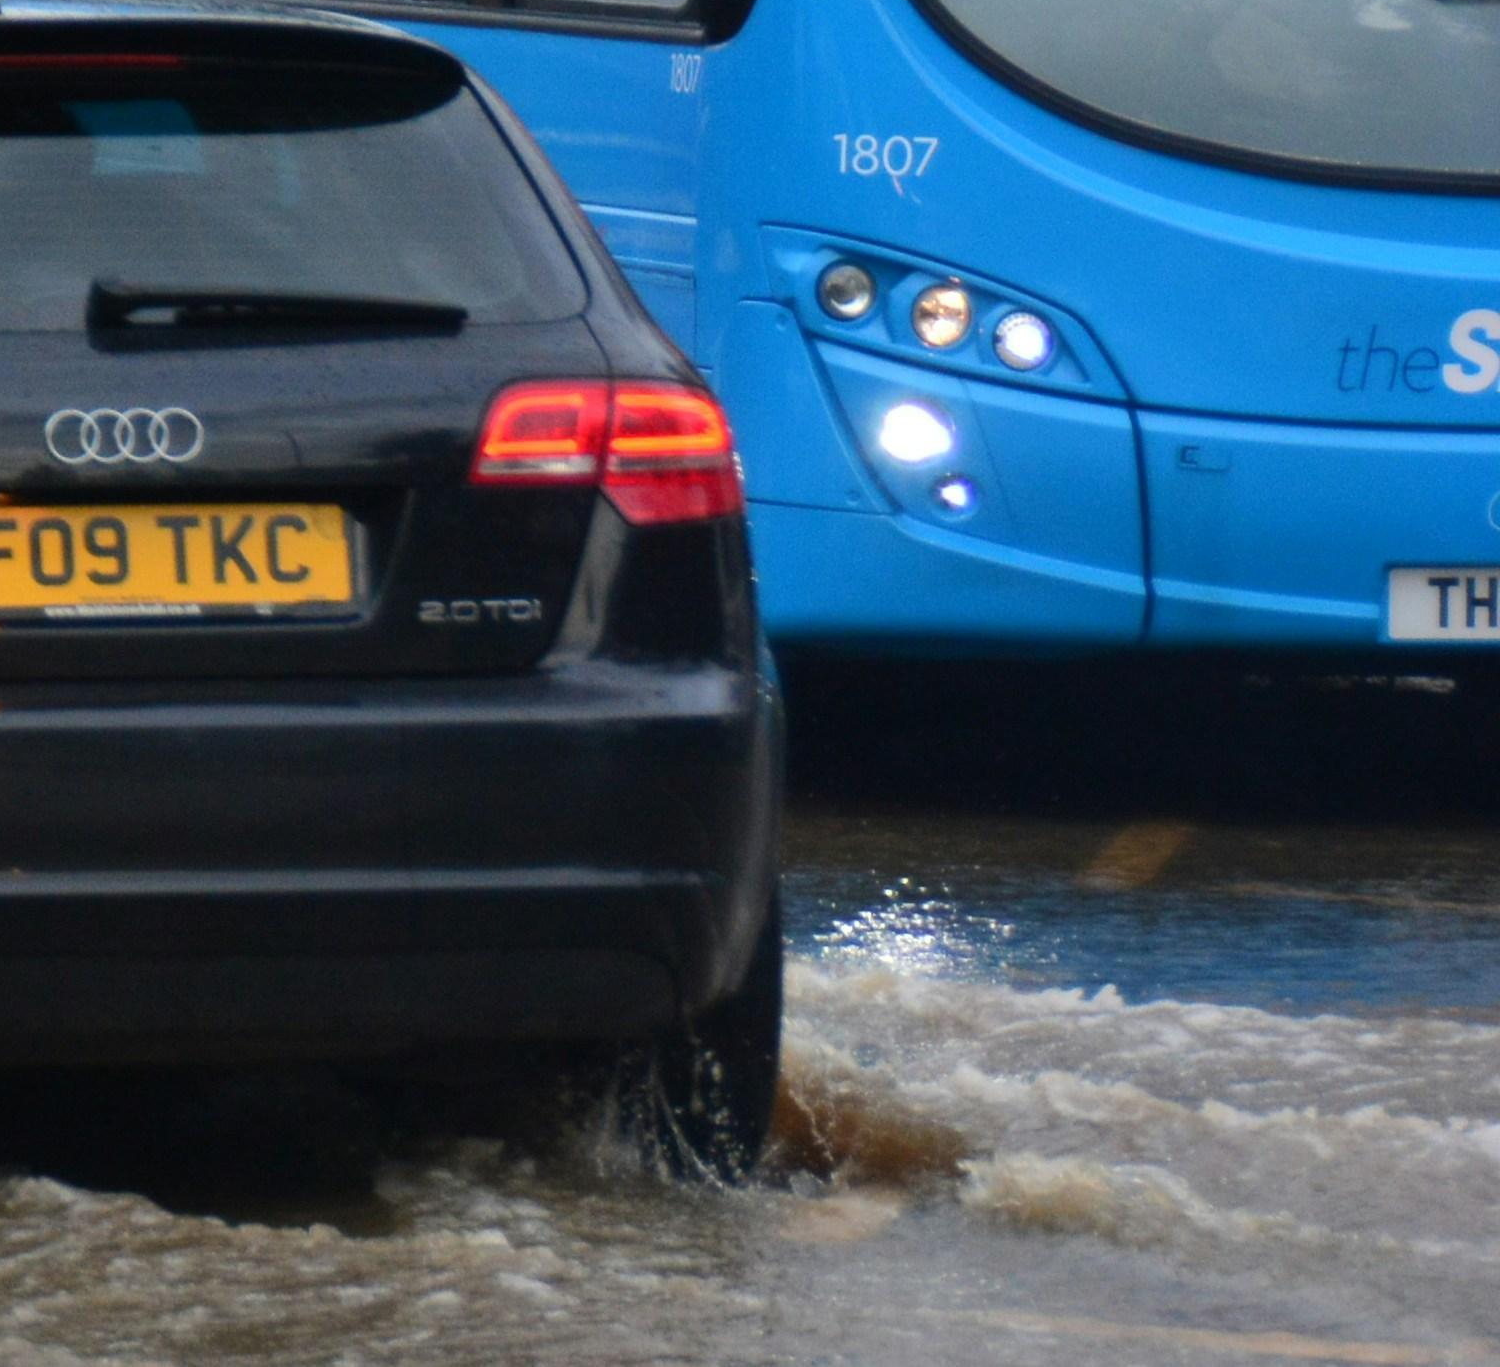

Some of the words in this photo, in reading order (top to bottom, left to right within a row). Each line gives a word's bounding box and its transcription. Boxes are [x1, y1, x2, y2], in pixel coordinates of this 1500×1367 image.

[669, 53, 701, 93] 1807
[833, 133, 939, 176] 1807
[155, 514, 311, 586] TKC
